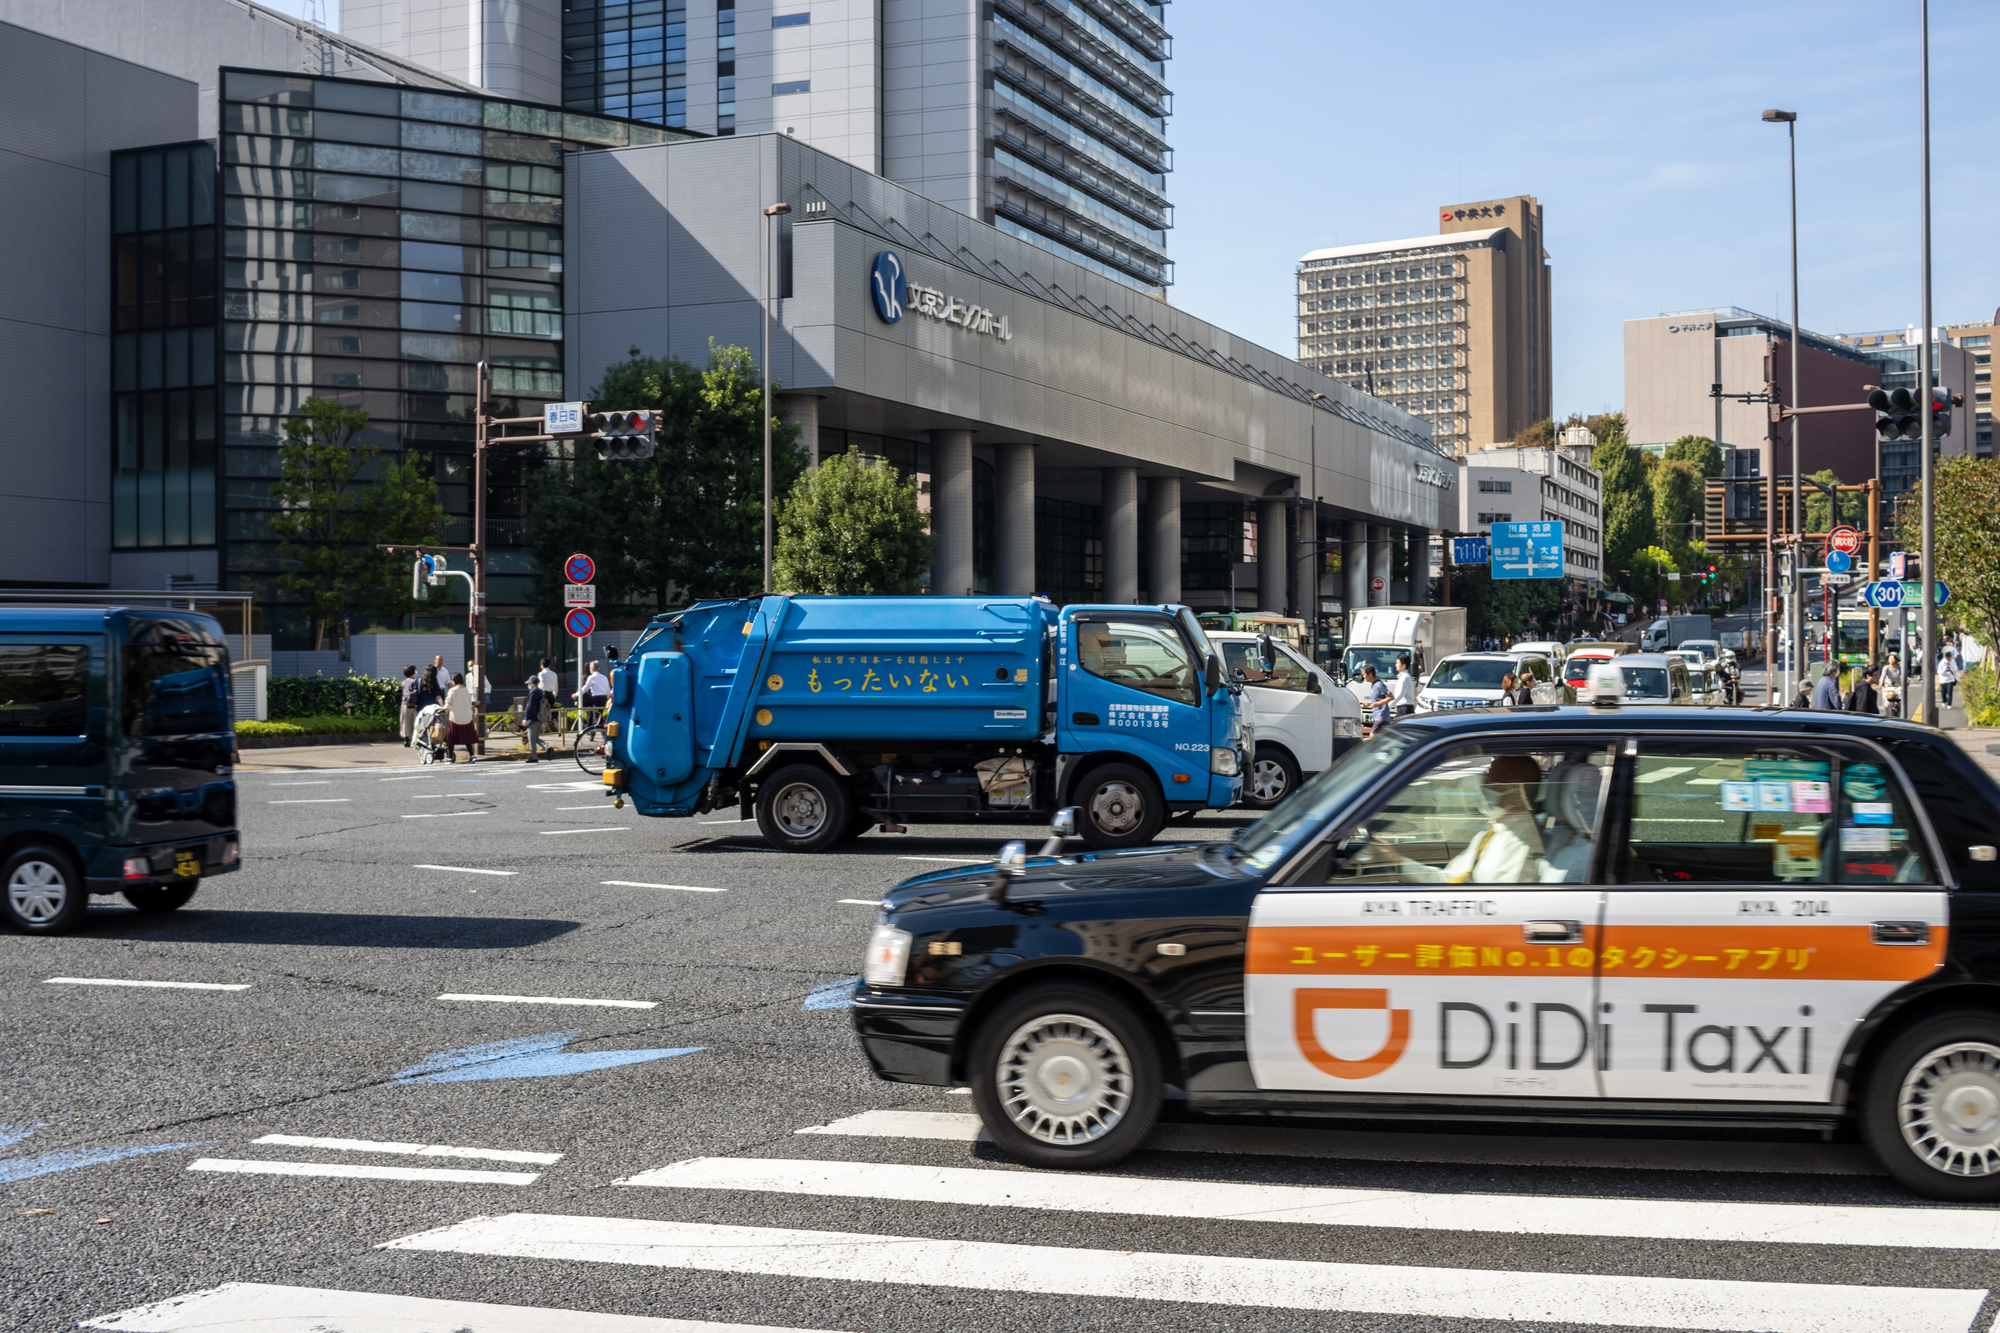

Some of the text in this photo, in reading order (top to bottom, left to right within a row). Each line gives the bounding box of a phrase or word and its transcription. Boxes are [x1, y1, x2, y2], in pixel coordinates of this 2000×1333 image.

[1454, 204, 1506, 222] 中央大学
[907, 281, 1012, 341] 文京シビックホール
[549, 410, 578, 423] 春日町
[1508, 523, 1551, 532] 川越 池袋
[1834, 537, 1854, 546] 消火栓
[1494, 547, 1520, 555] 後楽園
[1540, 546, 1559, 554] 大塚
[1877, 587, 1901, 602] 301
[807, 668, 969, 693] もったいない
[1108, 719, 1169, 728] 第000138号
[1175, 743, 1210, 752] NO.223
[1360, 900, 1498, 916] AYA TRAFFIC
[1737, 900, 1831, 916] AYA 204
[1437, 1001, 1815, 1074] DiDi Taxi
